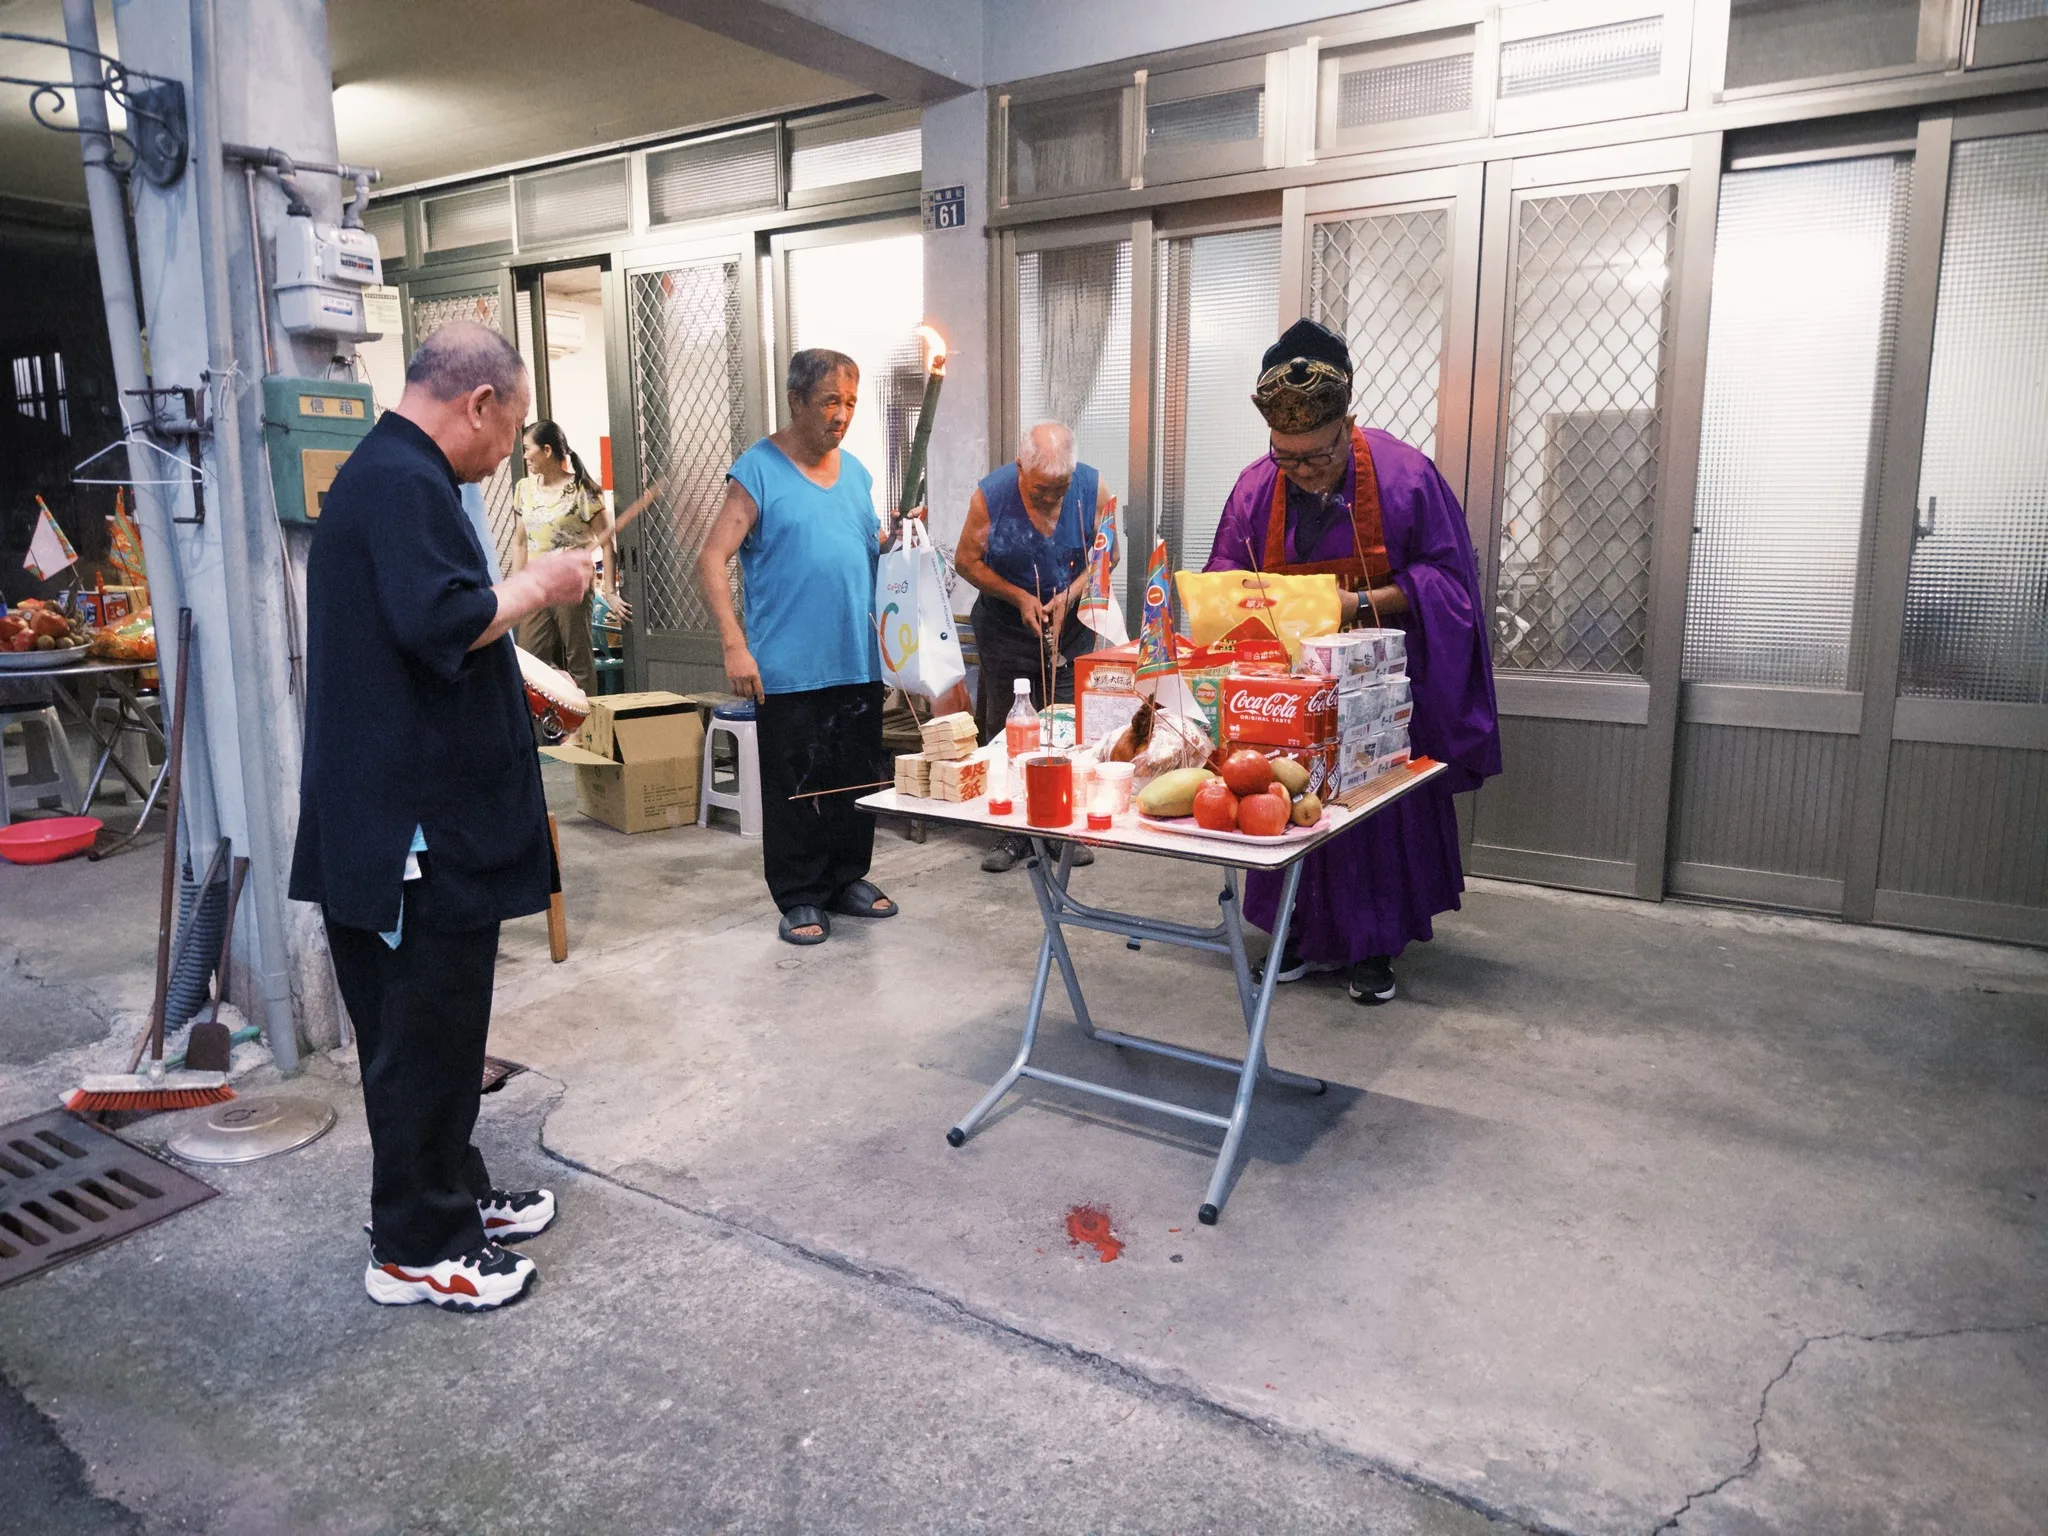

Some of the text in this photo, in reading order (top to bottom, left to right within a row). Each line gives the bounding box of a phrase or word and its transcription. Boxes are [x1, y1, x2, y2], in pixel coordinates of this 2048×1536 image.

[940, 204, 957, 227] 61
[310, 397, 352, 415] 信箱
[943, 605, 952, 630] MOMENT
[1230, 689, 1302, 719] Coca-Cola
[1240, 714, 1269, 722] ORIGINAL
[960, 761, 986, 802] 銀紙
